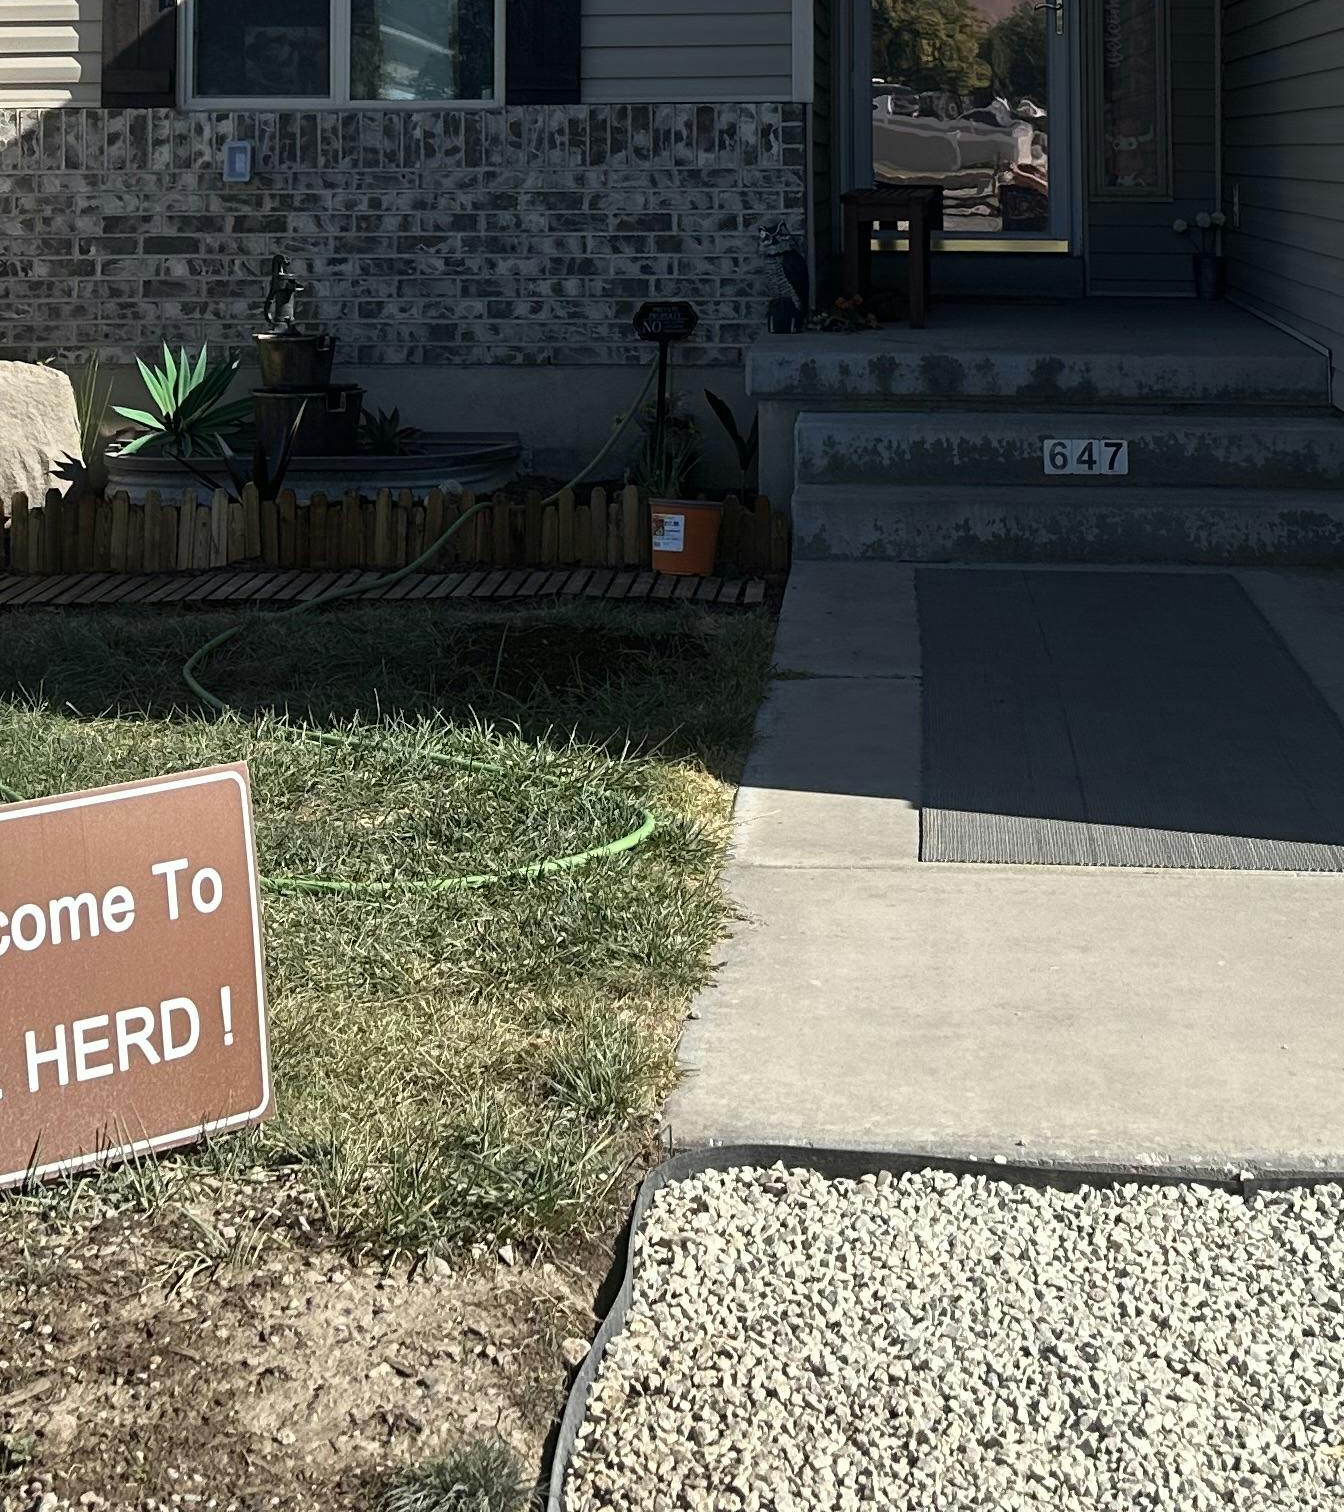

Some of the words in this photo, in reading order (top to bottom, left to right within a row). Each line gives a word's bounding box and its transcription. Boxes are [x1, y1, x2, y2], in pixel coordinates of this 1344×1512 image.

[1048, 440, 1124, 471] 647
[151, 857, 223, 921] To
[25, 997, 201, 1093] HERD
[220, 985, 234, 1046] !
